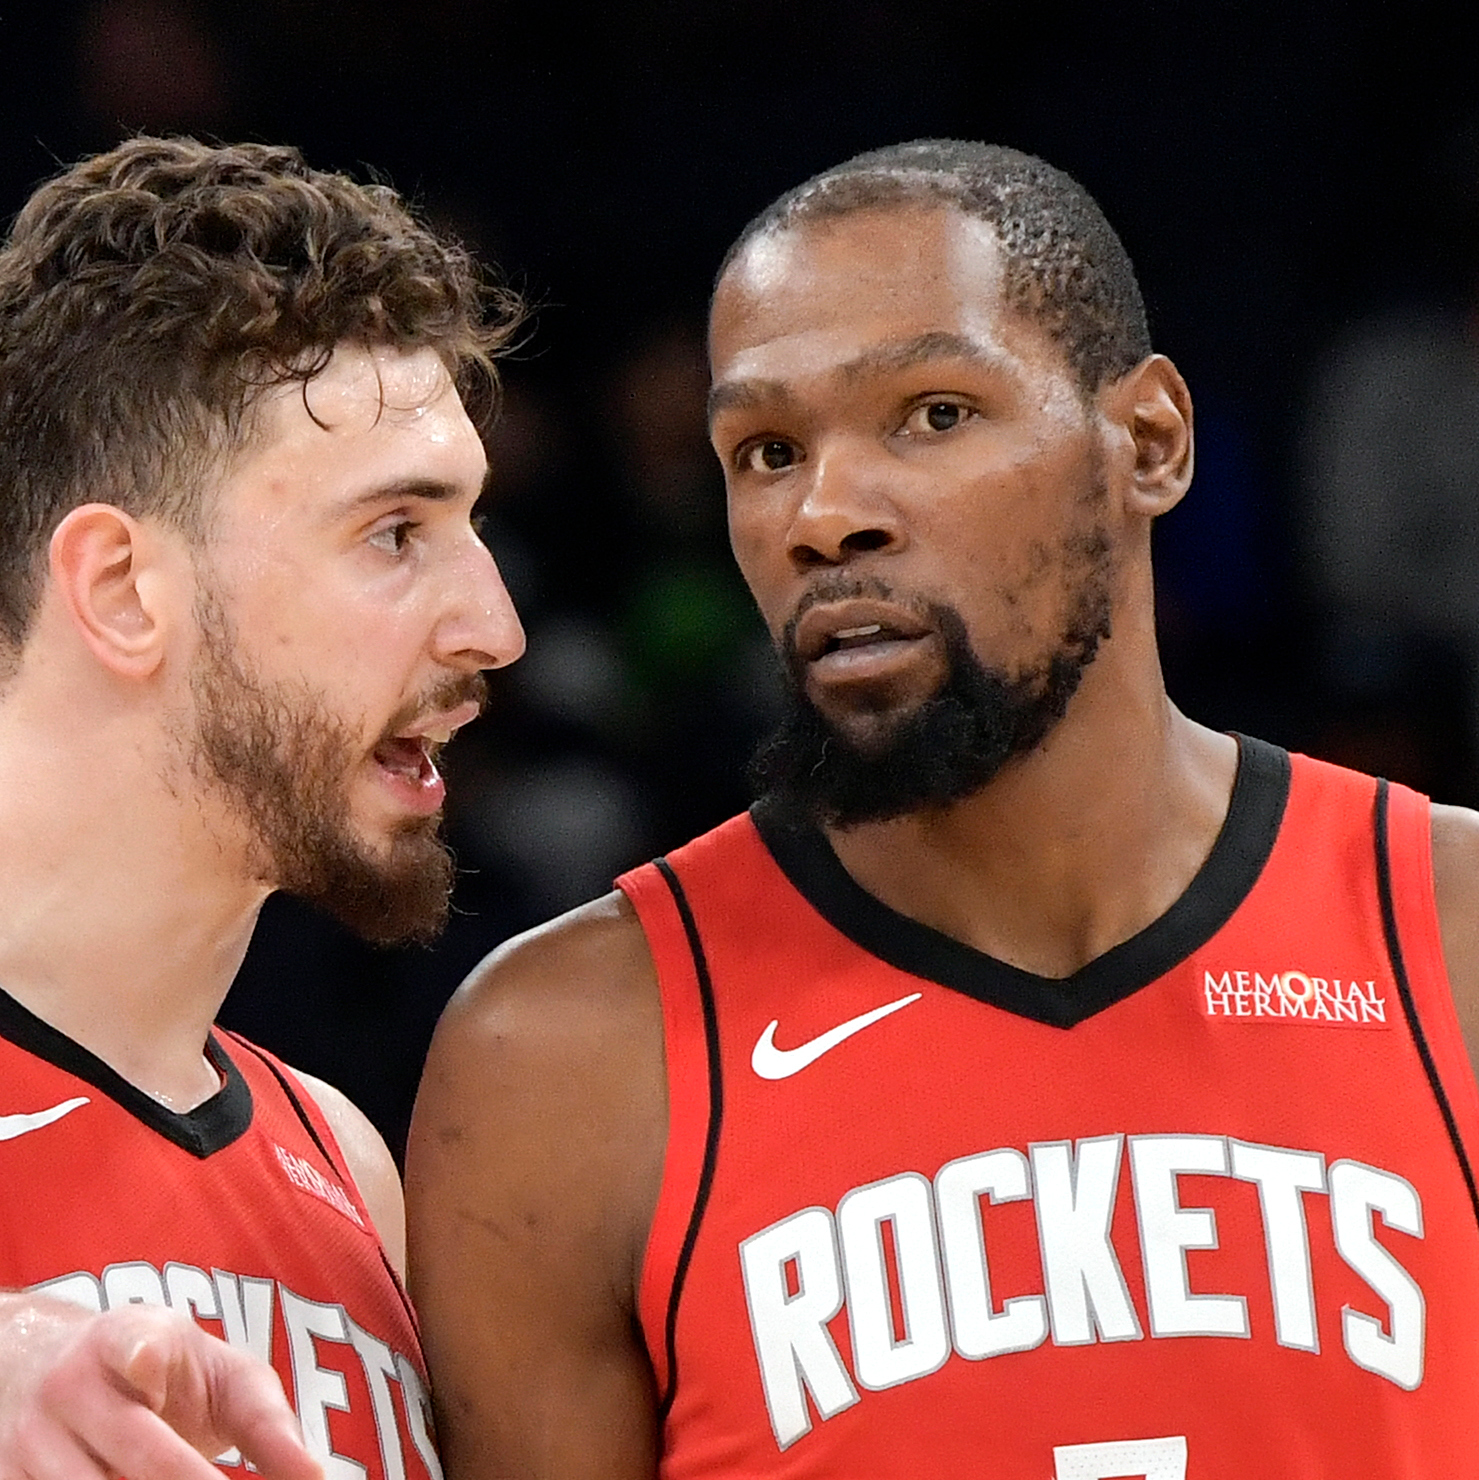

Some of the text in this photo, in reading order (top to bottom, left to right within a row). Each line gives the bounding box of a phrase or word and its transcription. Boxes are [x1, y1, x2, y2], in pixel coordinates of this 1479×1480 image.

[1204, 970, 1385, 1003] MEMORIAL
[1206, 992, 1386, 1022] HERMANN
[739, 1132, 1425, 1453] ROCKETS
